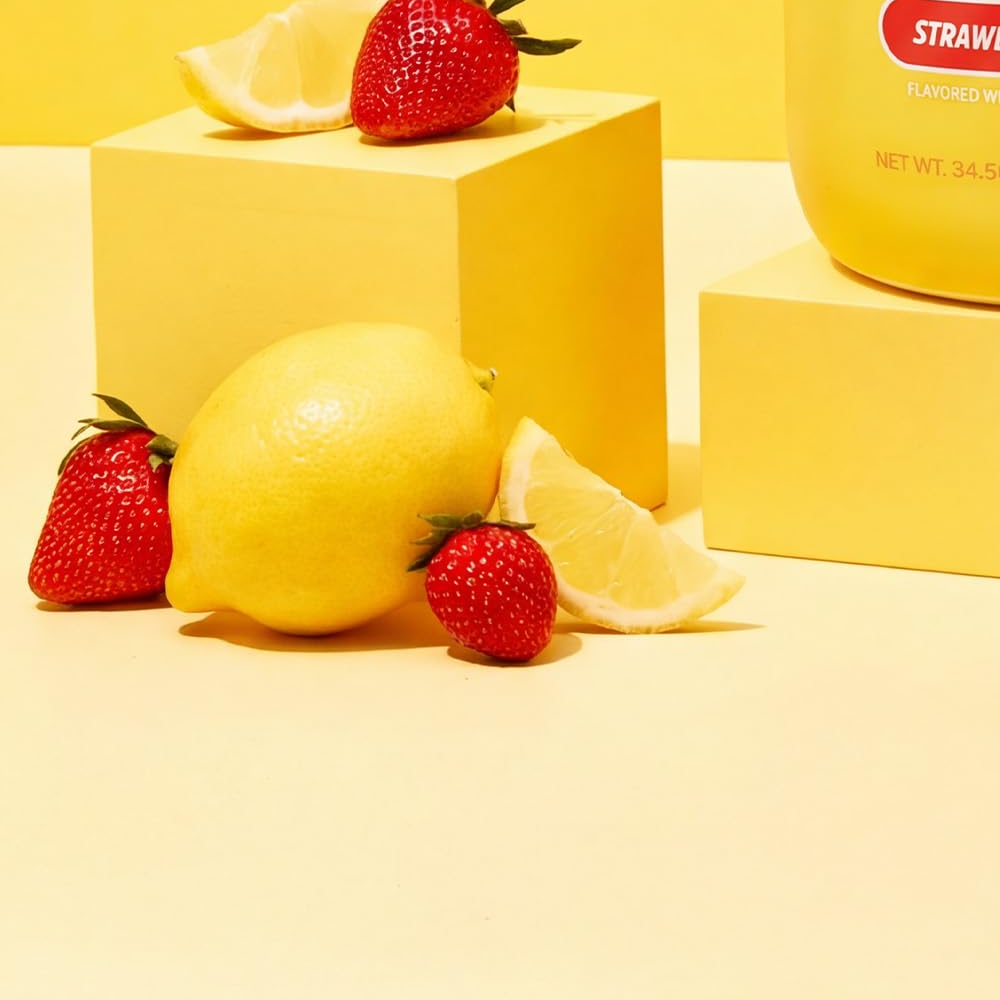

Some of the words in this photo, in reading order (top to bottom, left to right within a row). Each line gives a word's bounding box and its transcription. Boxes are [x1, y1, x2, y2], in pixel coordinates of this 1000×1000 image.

[907, 82, 980, 102] FLAVORED
[875, 150, 909, 172] NET
[914, 155, 947, 176] WT.
